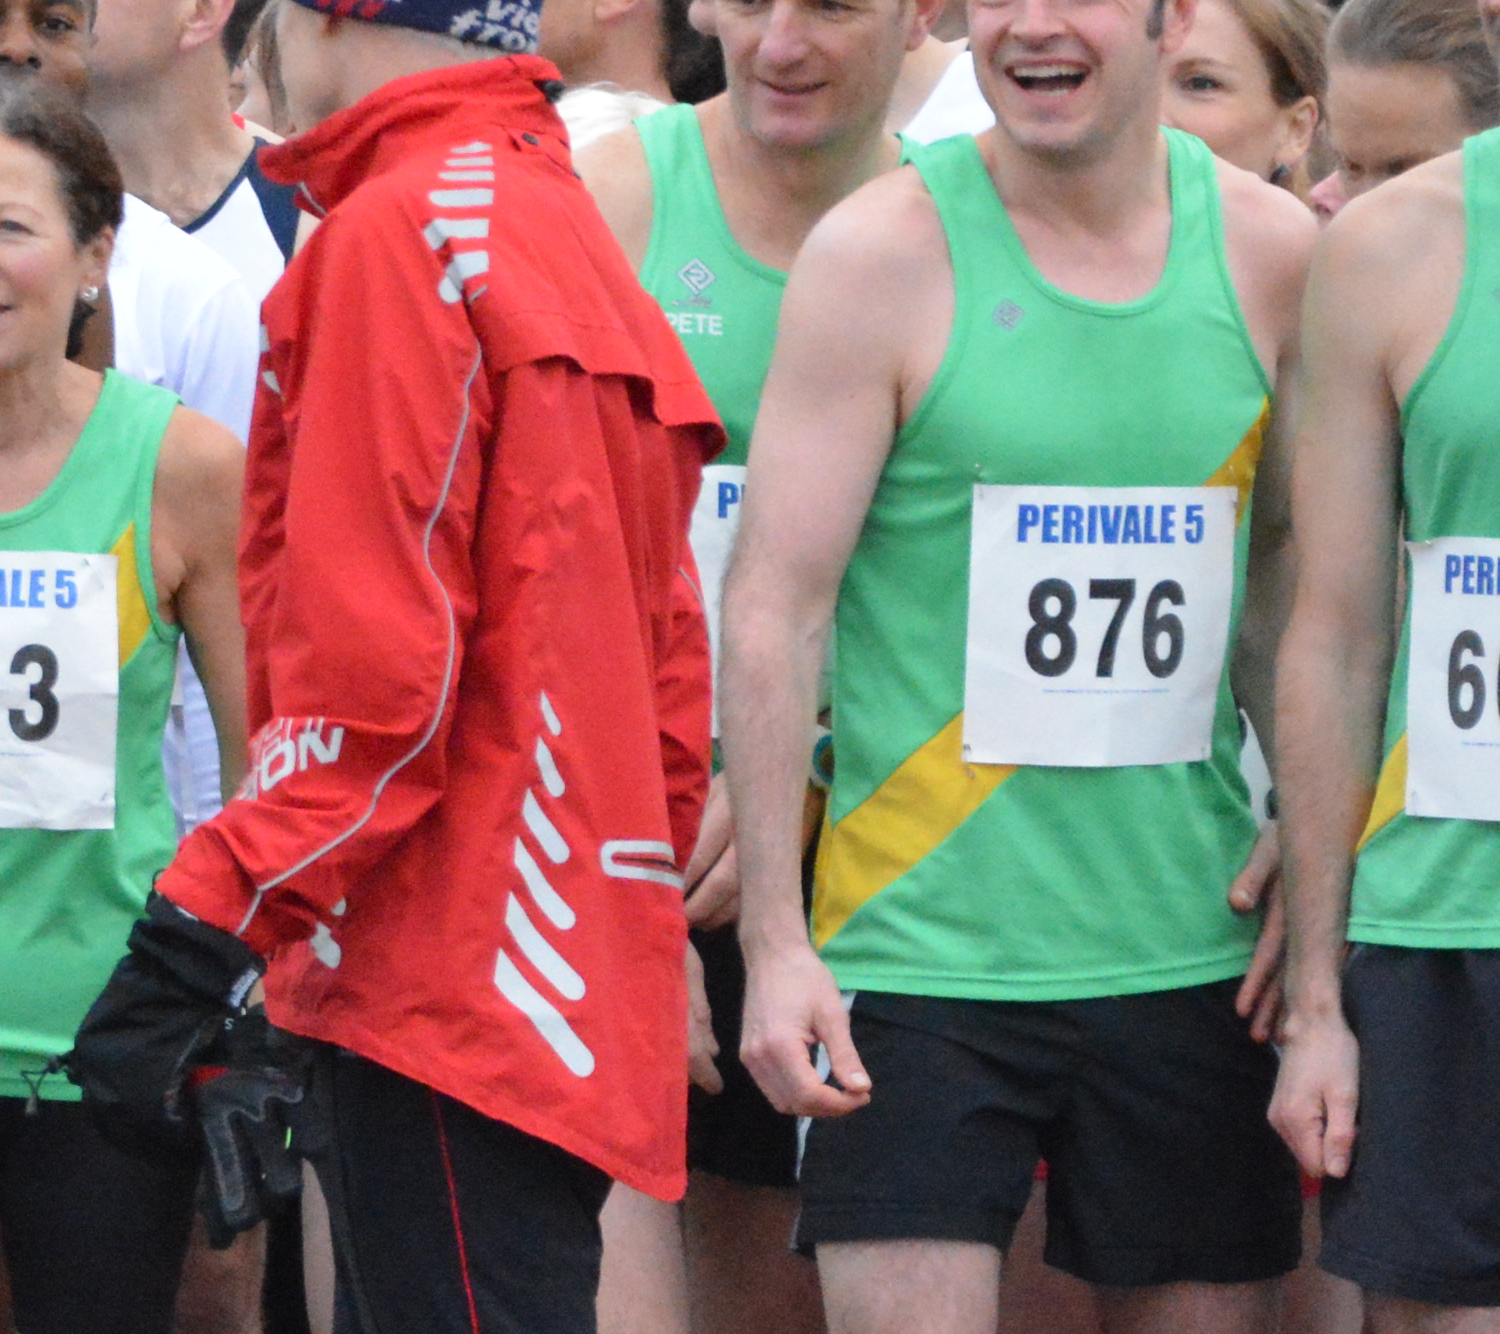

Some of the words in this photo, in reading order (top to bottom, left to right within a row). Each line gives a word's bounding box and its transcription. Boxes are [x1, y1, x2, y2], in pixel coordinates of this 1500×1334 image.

[1017, 503, 1176, 545] PERIVALE
[1184, 504, 1205, 545] 5
[55, 569, 79, 609] 5
[1024, 577, 1187, 679] 876
